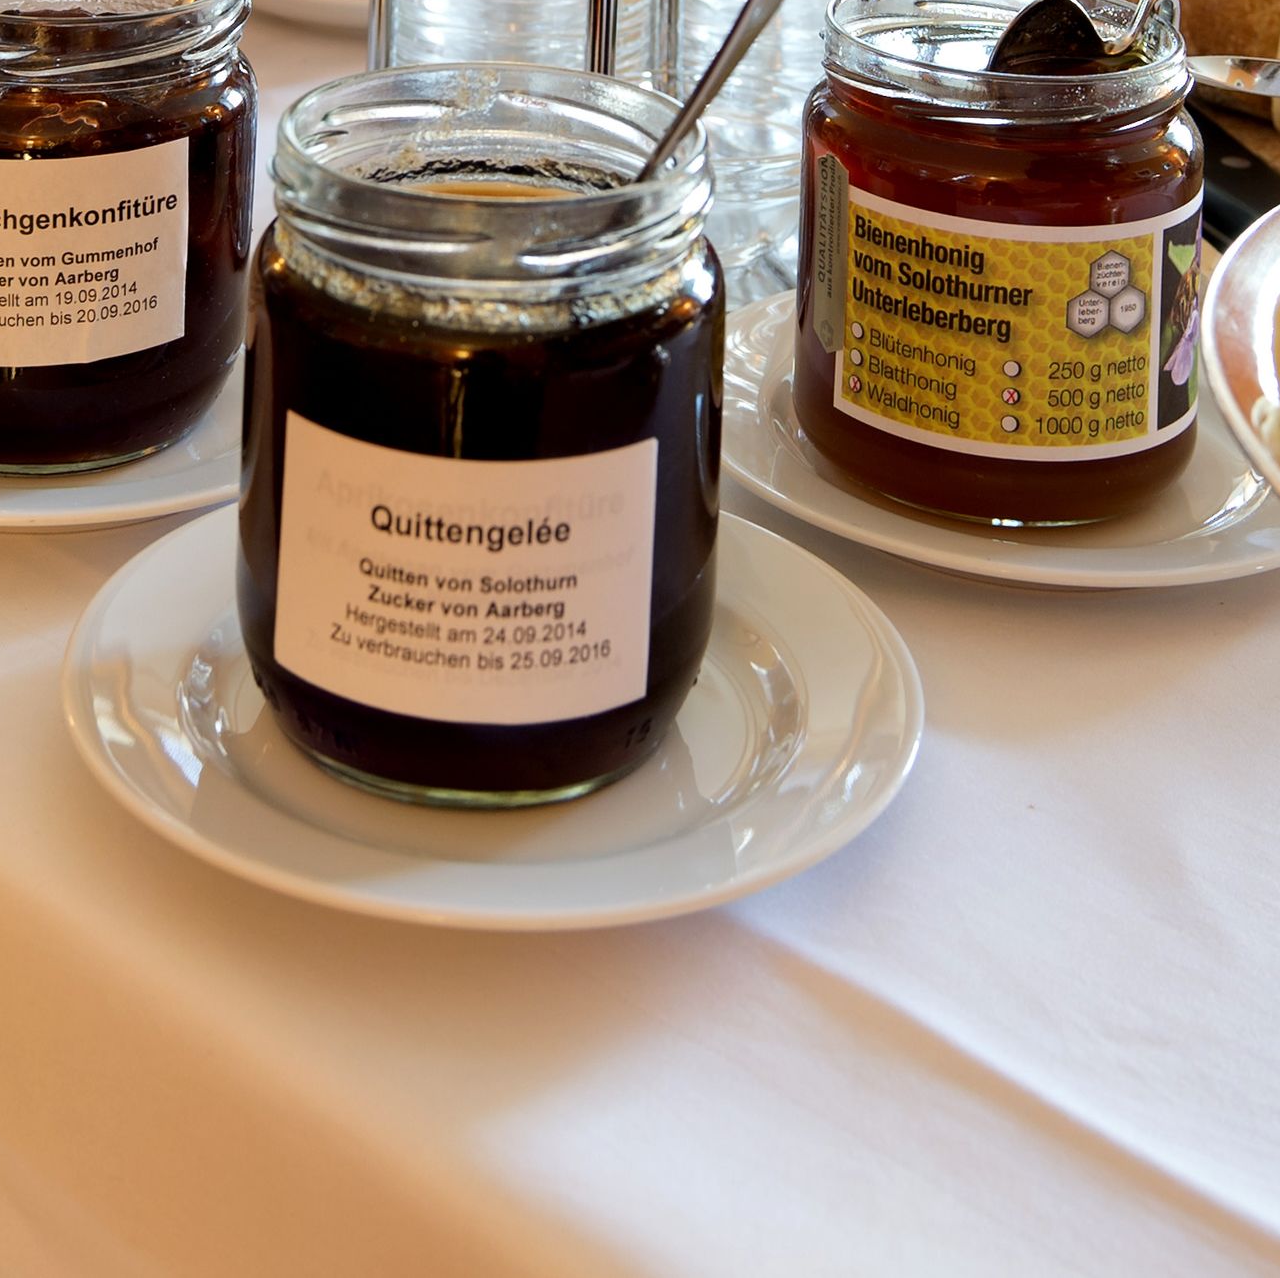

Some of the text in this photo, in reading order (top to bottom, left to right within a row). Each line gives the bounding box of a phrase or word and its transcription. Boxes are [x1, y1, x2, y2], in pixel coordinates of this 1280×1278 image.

[20, 256, 56, 267] vom
[61, 236, 159, 266] Gummenhof
[854, 215, 985, 275] Bienenhonig
[19, 274, 49, 287] von
[55, 267, 120, 286] Aarberg
[24, 294, 49, 307] am
[55, 281, 138, 306] 19.09.2014
[853, 248, 1033, 307] vom Solothurner
[50, 310, 72, 326] bis
[77, 295, 158, 324] 20.09.2016
[852, 277, 1012, 343] Unterleberberg
[1077, 316, 1096, 325] berg
[869, 329, 977, 377] Blütenhonig
[1047, 356, 1147, 383] 250 g netto
[868, 356, 958, 401] Blatthonig
[1047, 383, 1145, 411] 500 g netto
[867, 381, 961, 429] Waldhonig
[1035, 410, 1145, 439] 1000 g netto
[370, 504, 571, 553] Quittengelée
[358, 557, 578, 595] Quitten von Solothurn
[367, 584, 565, 620] Zucker von Aarberg
[345, 603, 587, 645] Hergestellt am 24.09.2014
[329, 623, 612, 671] Zu verbrauchen bis 25.09.2016
